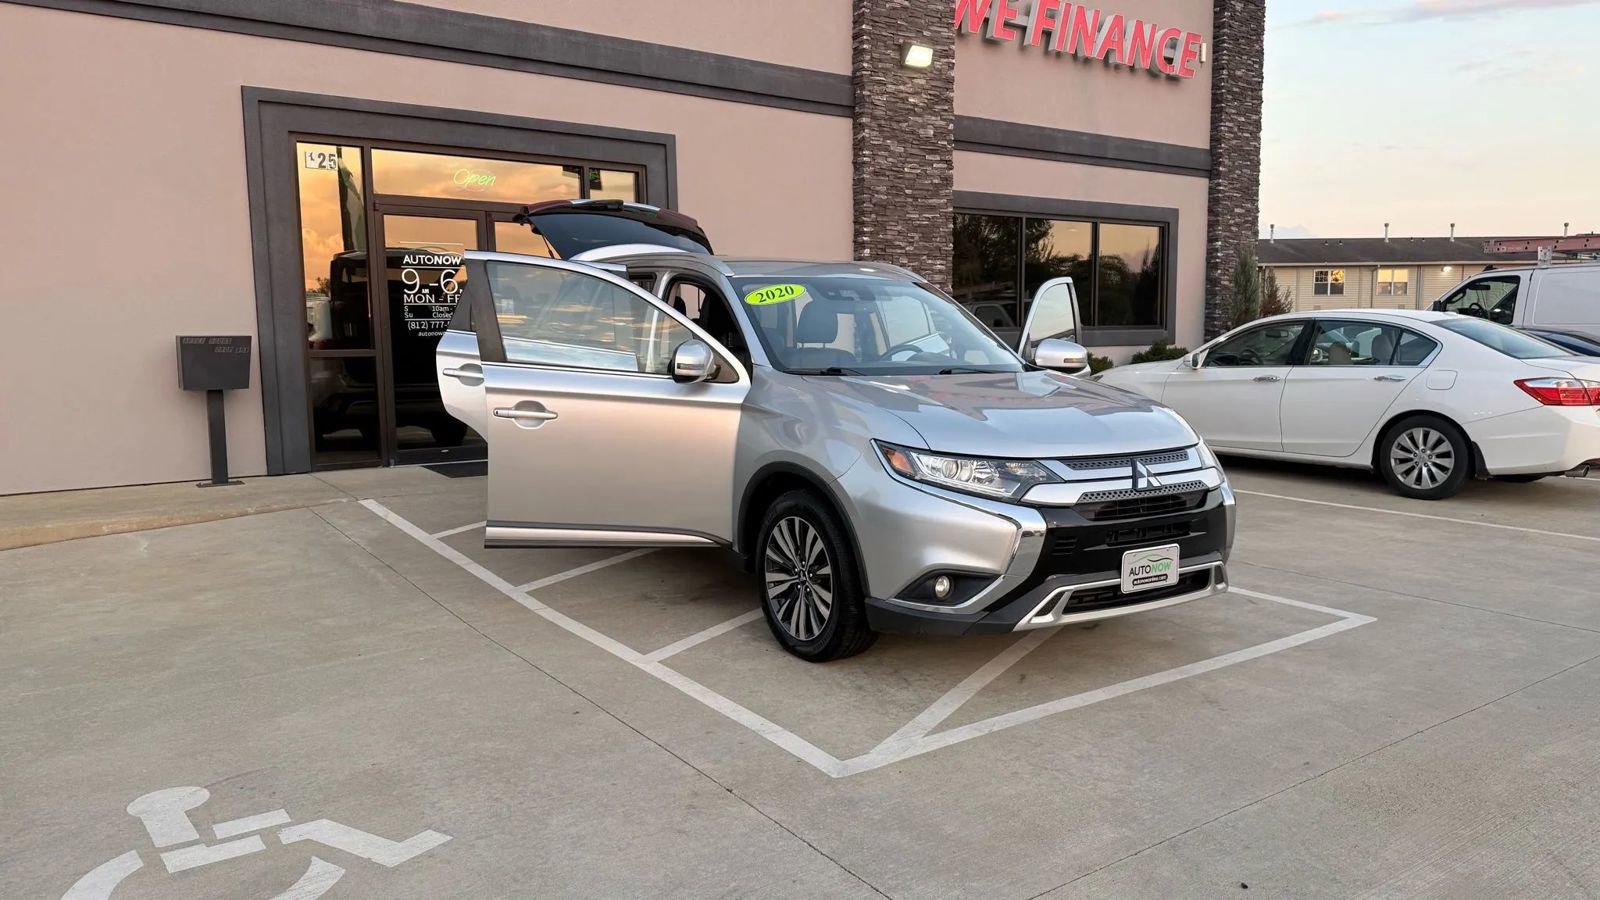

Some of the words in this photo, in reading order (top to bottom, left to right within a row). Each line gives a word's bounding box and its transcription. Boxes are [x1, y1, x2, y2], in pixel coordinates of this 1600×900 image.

[954, 0, 1018, 41] WE
[1030, 0, 1202, 78] FINANCE
[453, 168, 497, 188] Open
[403, 255, 461, 264] AUTONOW
[401, 268, 420, 294] 9
[403, 294, 435, 304] MON
[755, 285, 795, 303] 2020
[407, 320, 429, 331] (812)
